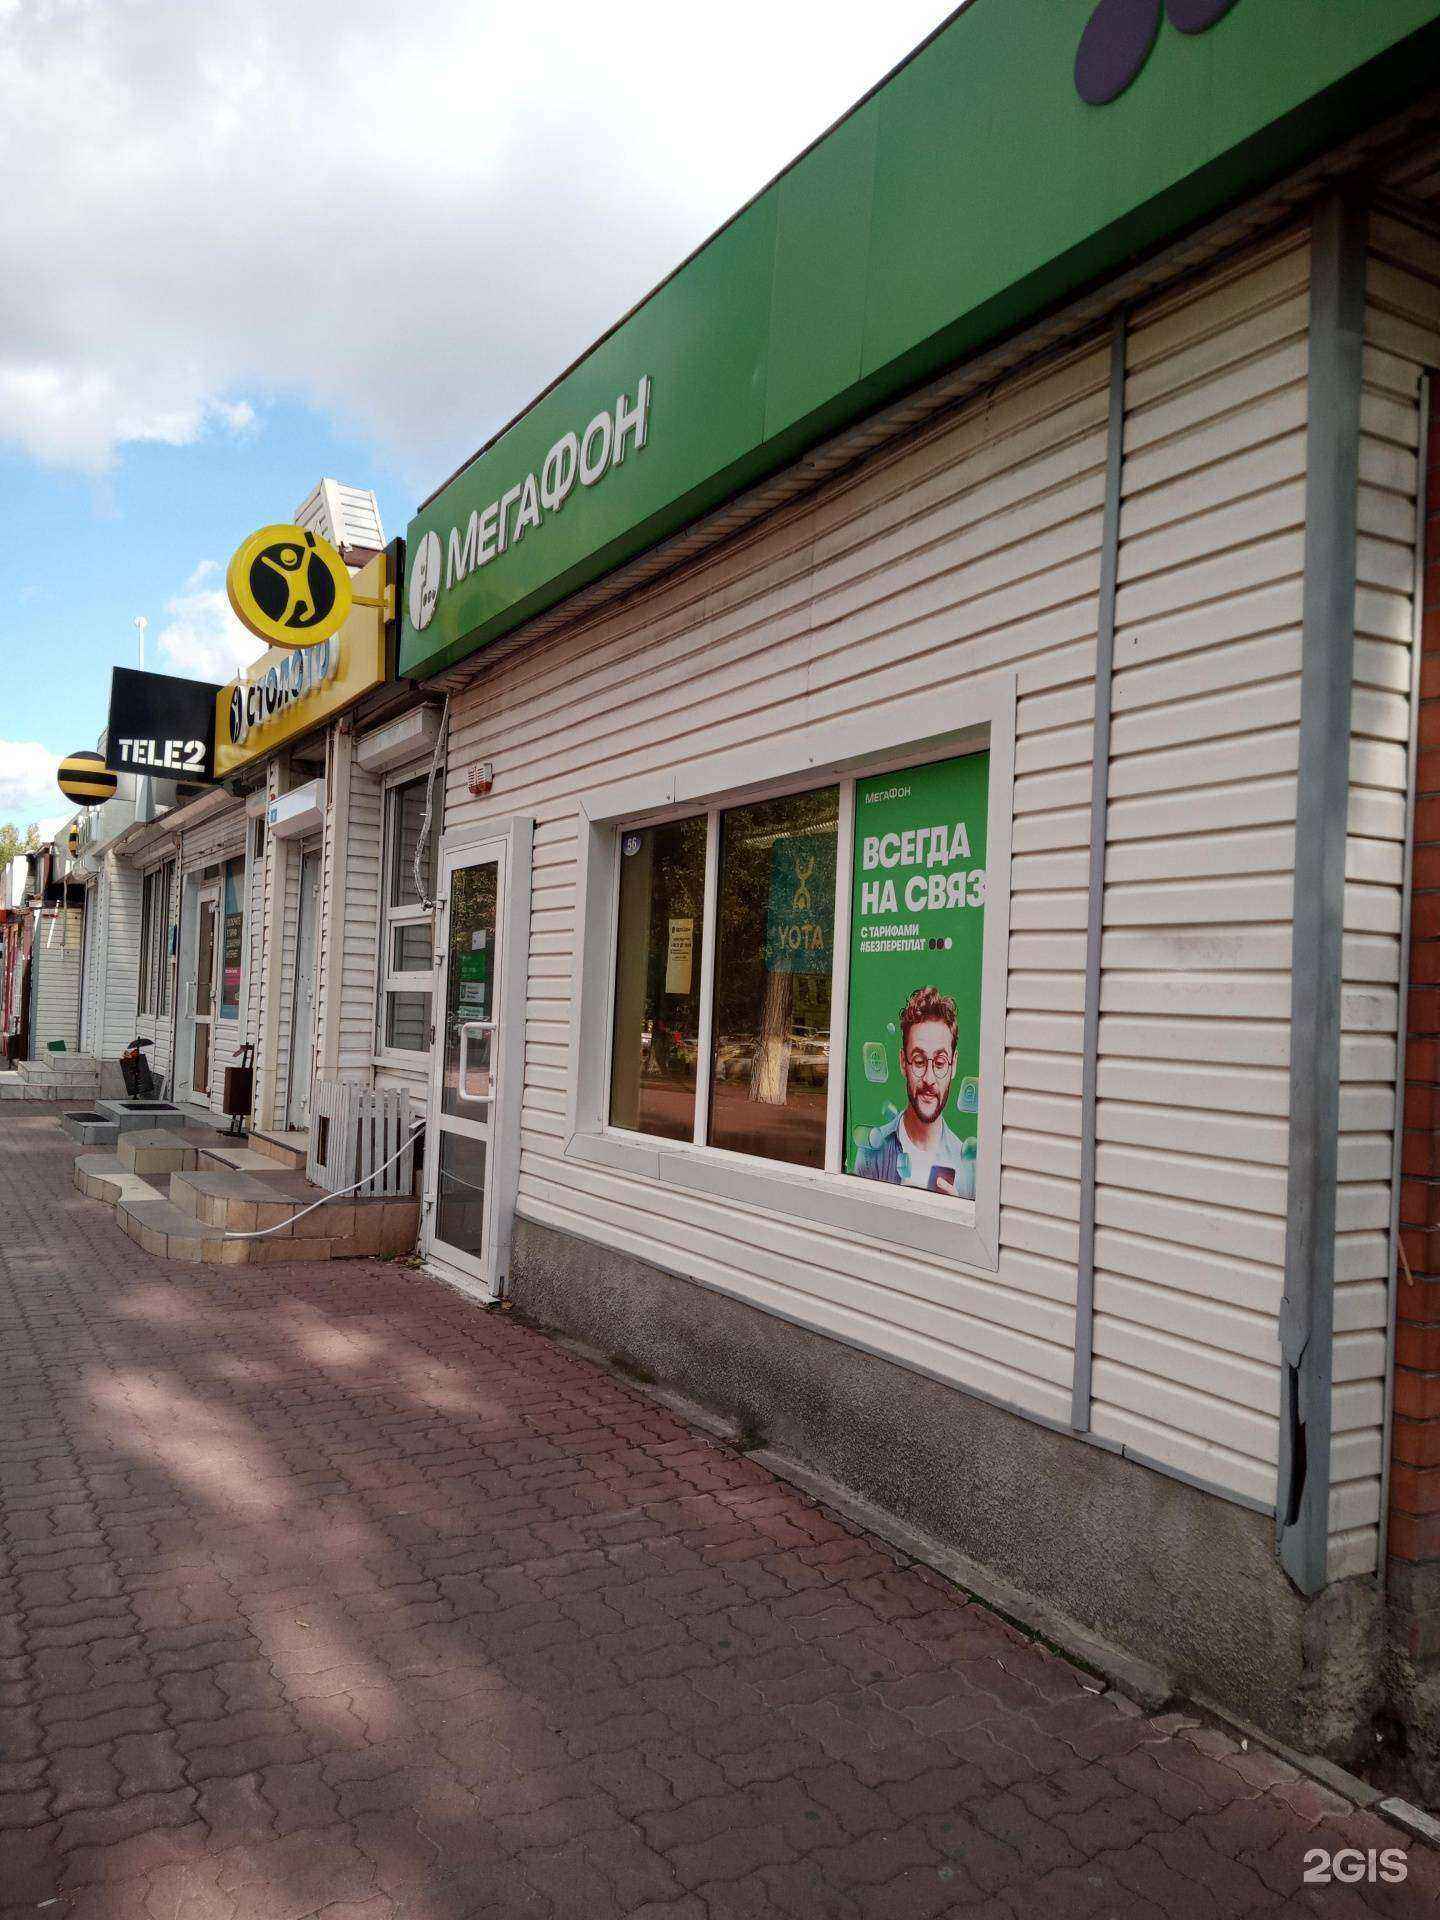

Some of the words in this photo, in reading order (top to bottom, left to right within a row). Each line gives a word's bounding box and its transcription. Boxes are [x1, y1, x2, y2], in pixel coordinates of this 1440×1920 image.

[446, 374, 652, 592] МЕГАФОН
[118, 738, 207, 773] TELE2
[865, 786, 911, 804] МЕГАФОН
[862, 822, 972, 871] ВСЕГДА
[861, 879, 899, 915] НА
[778, 923, 824, 951] YOTA
[860, 926, 868, 938] С
[869, 923, 919, 938] ТАРИФАМИ
[860, 938, 926, 952] #БЕЗПЕРЕПЛАТ
